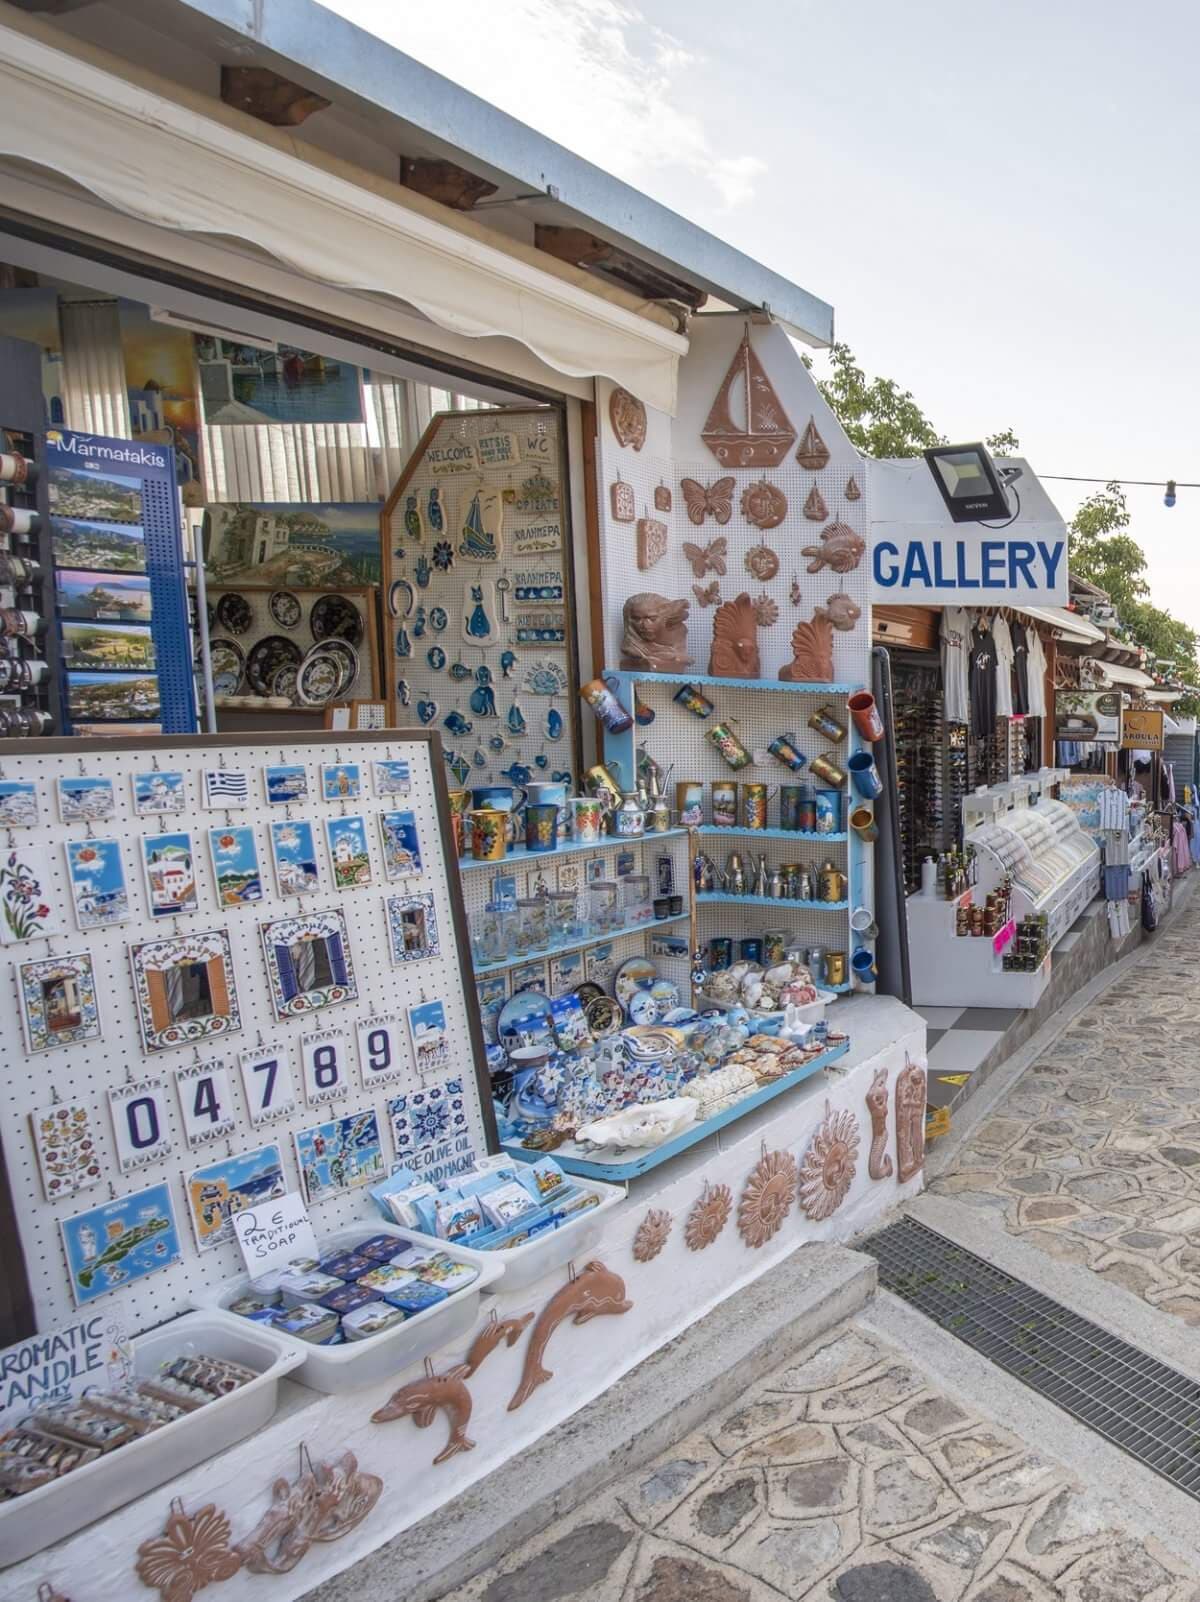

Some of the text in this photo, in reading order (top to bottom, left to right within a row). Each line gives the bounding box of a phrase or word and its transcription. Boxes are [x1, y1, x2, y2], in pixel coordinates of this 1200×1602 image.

[57, 438, 166, 467] Marmatakis
[426, 446, 473, 462] WELCOME
[873, 540, 1065, 590] GALLERY
[313, 1045, 337, 1089] 8
[367, 1029, 391, 1072] 9
[193, 1077, 220, 1122] 4
[253, 1060, 279, 1109] 7
[126, 1096, 160, 1149] 0
[424, 1141, 454, 1165] OLIVE
[455, 1136, 472, 1153] OIL
[424, 1165, 444, 1184] AND
[236, 1212, 266, 1236] 2
[242, 1216, 311, 1247] TRADITIONAL
[255, 1233, 297, 1258] SOAP
[0, 1316, 104, 1381] ROMATIC
[0, 1342, 104, 1412] ANDLE
